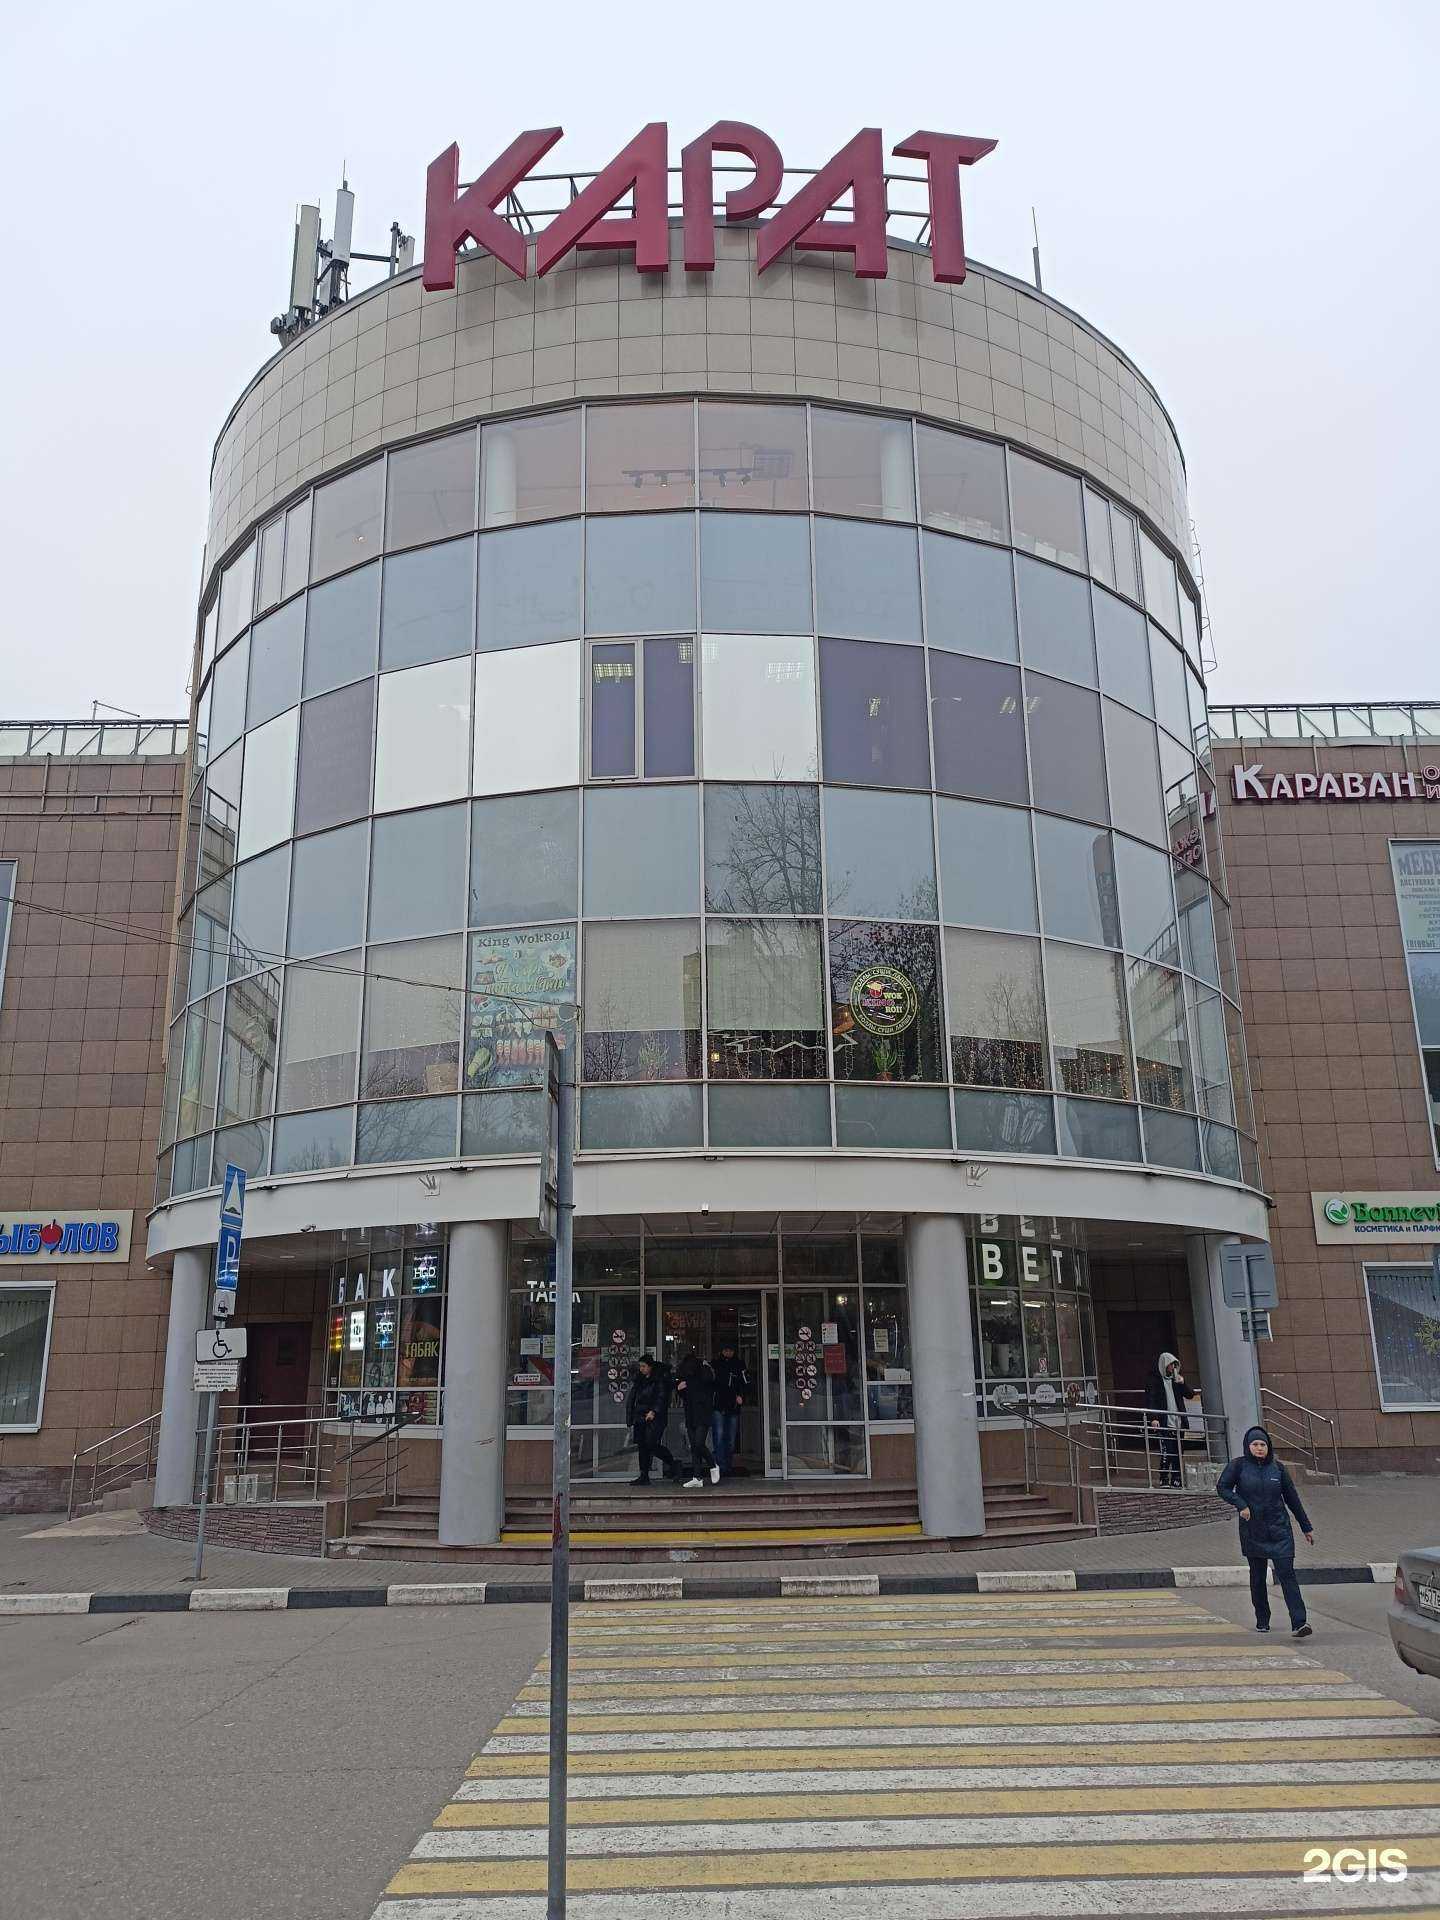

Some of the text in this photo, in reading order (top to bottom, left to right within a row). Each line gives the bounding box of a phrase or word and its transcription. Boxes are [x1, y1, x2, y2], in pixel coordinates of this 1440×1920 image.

[423, 120, 999, 291] КАРАТ
[1233, 764, 1417, 799] КАРАВАН
[1354, 1225, 1405, 1233] КОСМЕТИКА
[405, 1341, 439, 1358] ТАБАК
